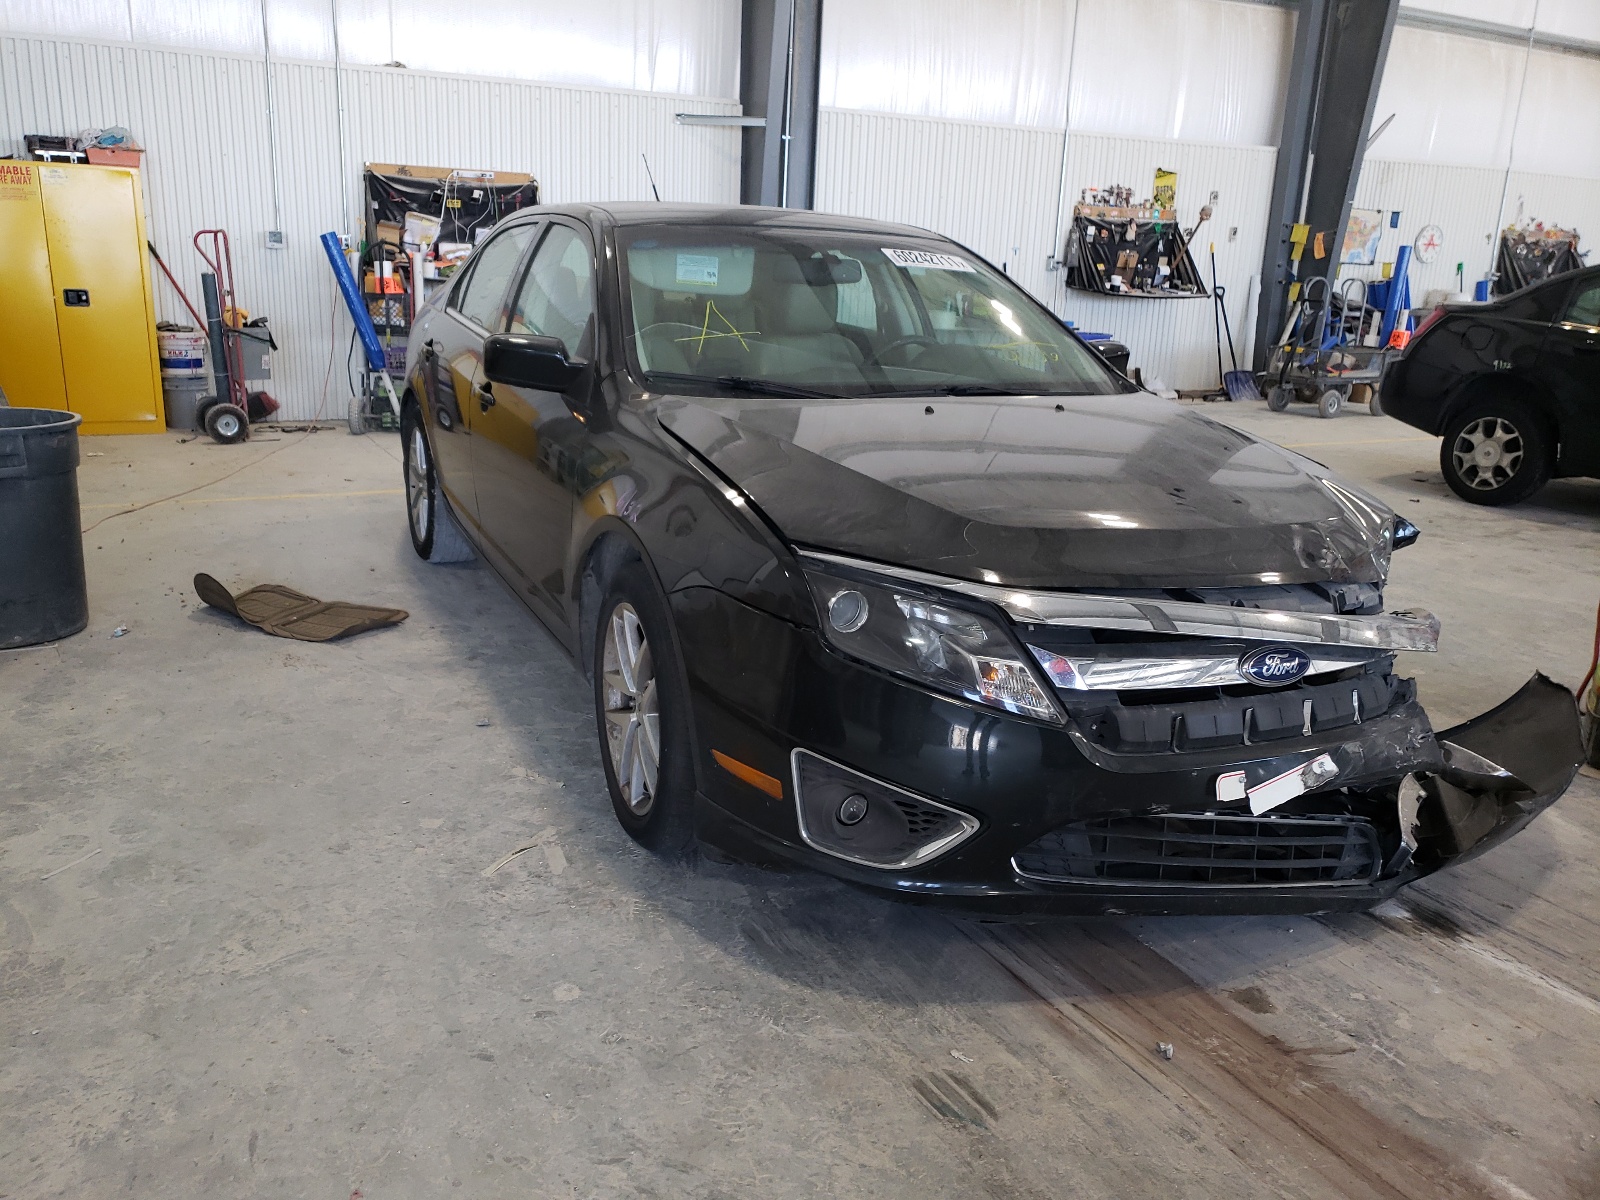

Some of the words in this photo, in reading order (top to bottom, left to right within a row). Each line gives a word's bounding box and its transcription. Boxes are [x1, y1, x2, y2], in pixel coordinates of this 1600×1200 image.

[11, 176, 31, 184] AWAY
[893, 250, 961, 268] 60242711
[1262, 653, 1299, 676] Ford
